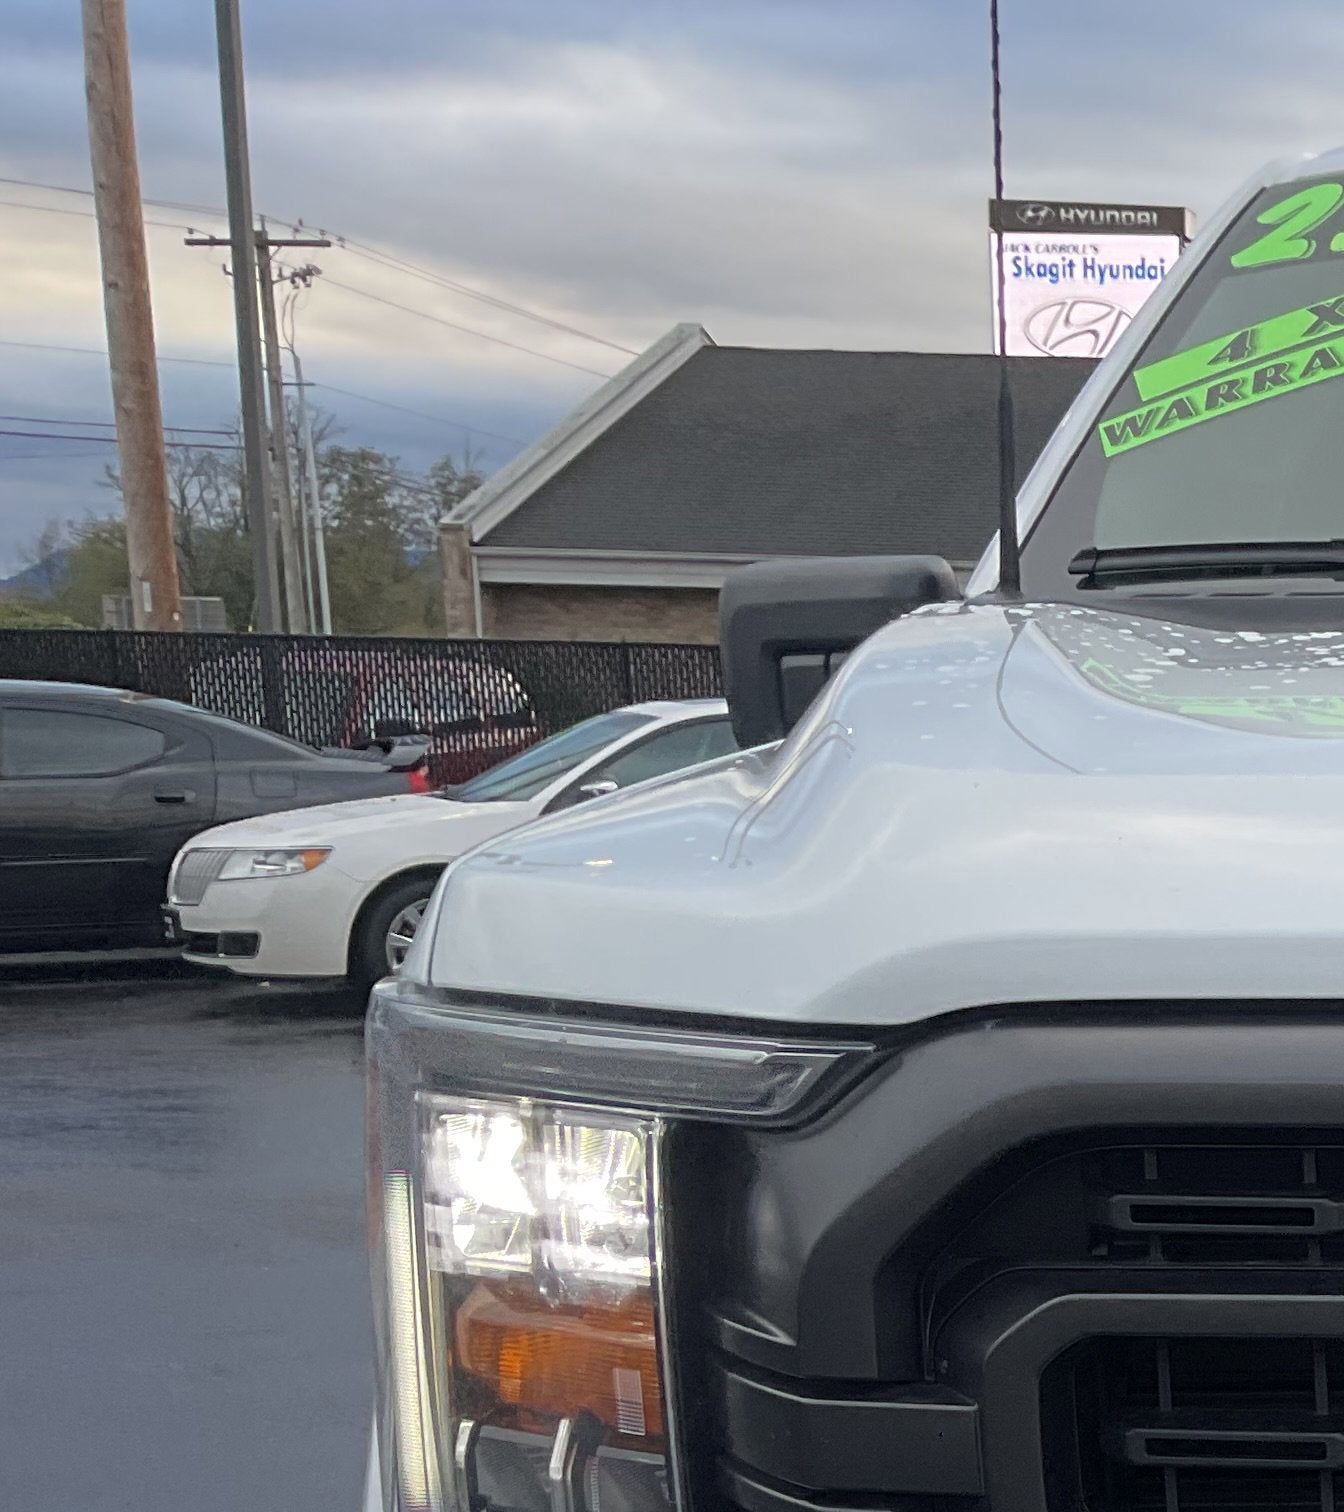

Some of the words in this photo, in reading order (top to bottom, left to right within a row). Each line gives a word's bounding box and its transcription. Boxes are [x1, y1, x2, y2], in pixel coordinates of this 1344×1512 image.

[1060, 208, 1157, 226] HYUNDAI
[1012, 256, 1076, 284] Skagit
[1083, 257, 1166, 285] Hyundai
